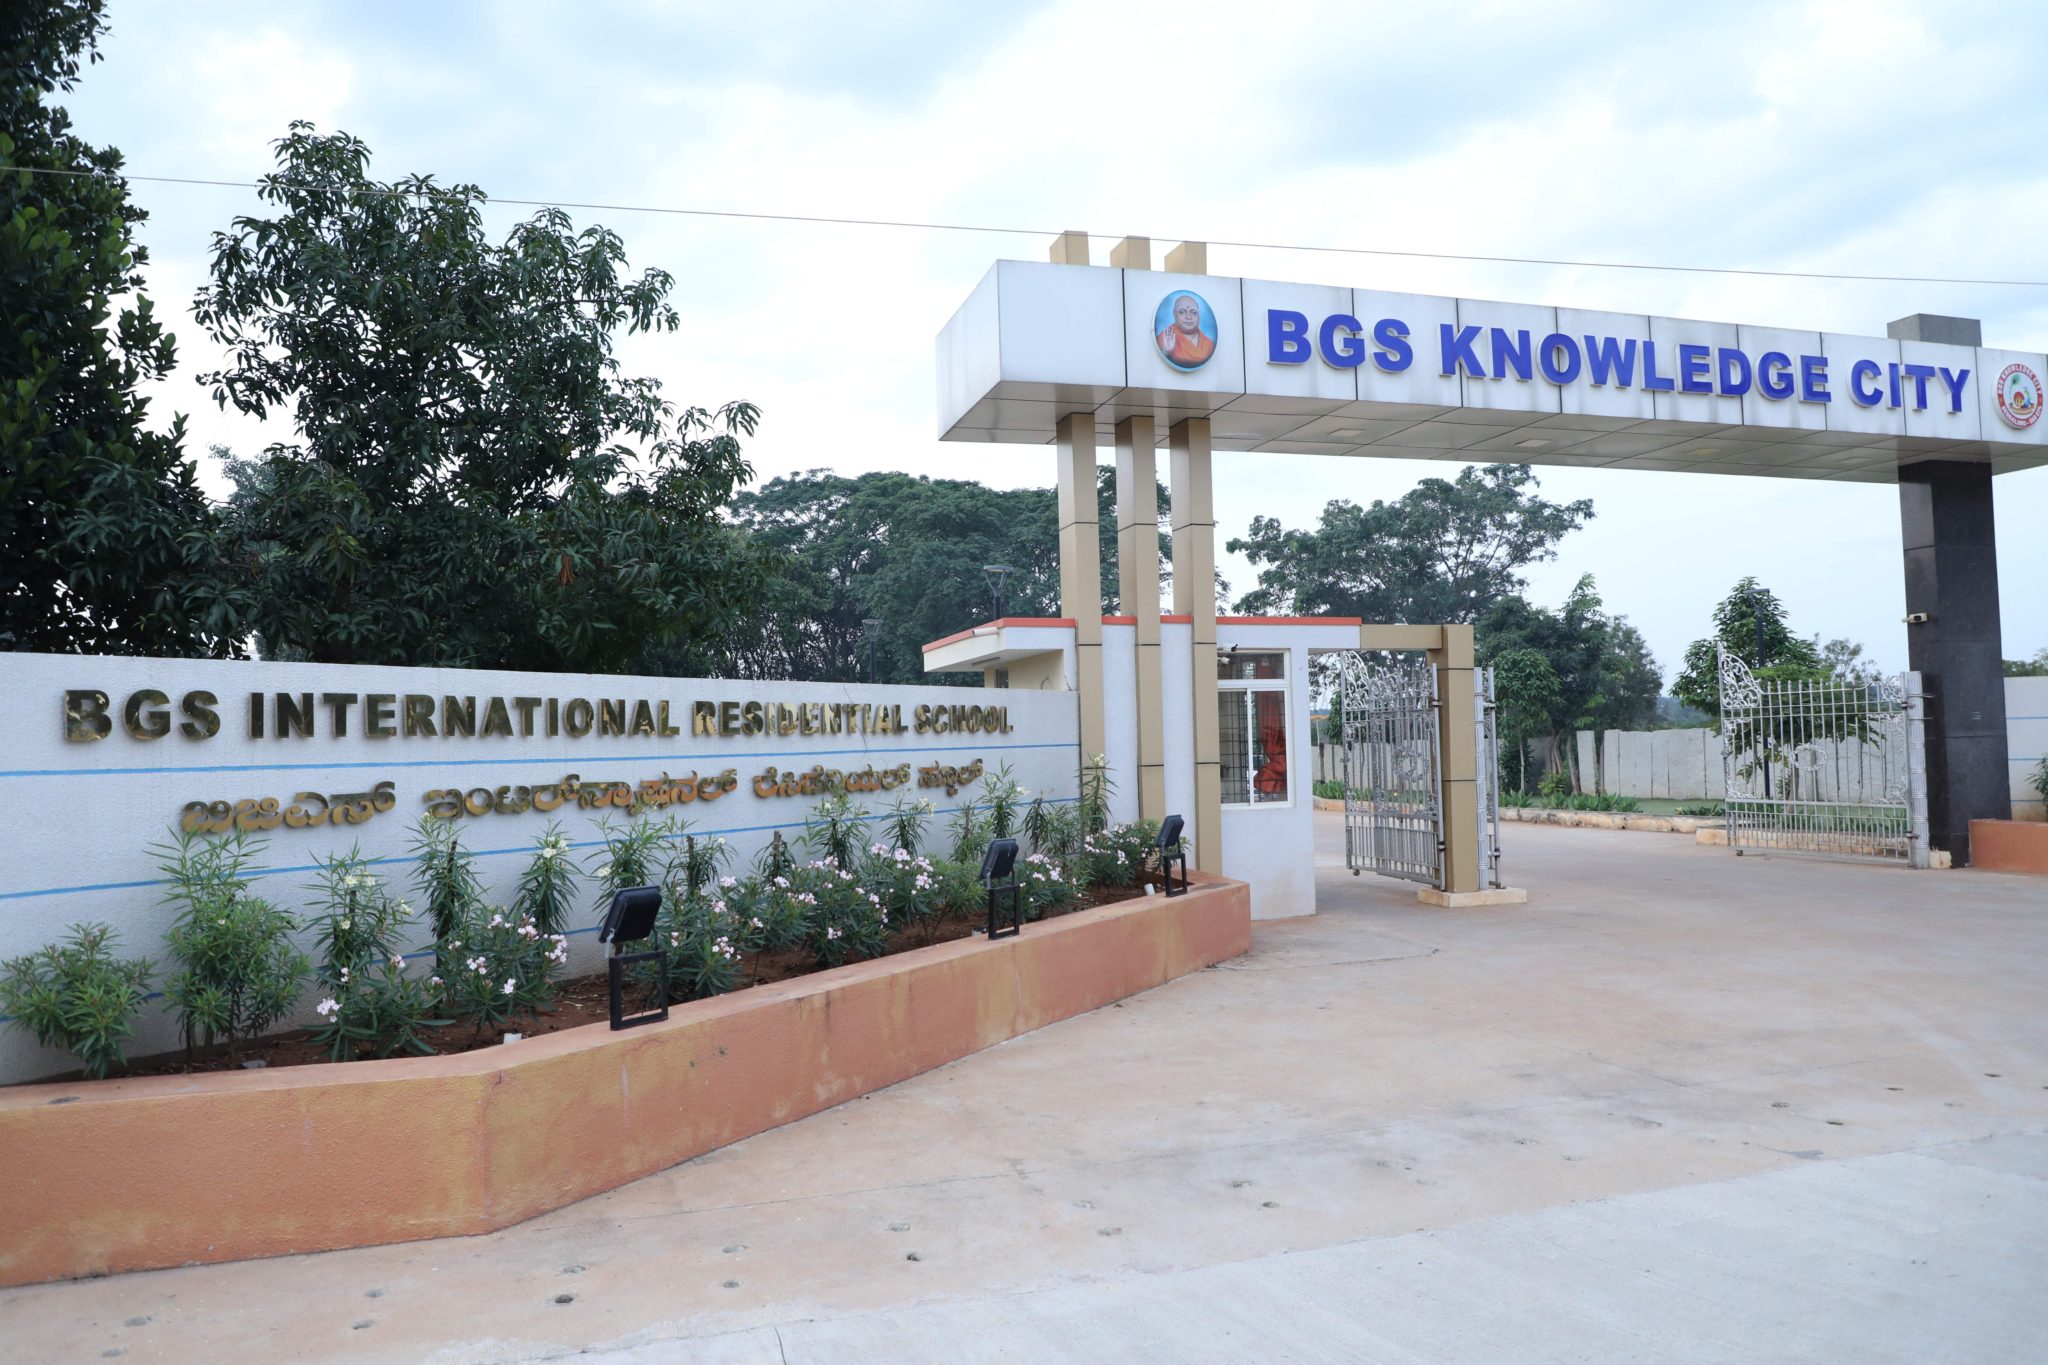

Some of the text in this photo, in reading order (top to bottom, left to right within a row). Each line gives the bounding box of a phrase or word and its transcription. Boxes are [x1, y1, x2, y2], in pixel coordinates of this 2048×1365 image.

[1267, 309, 1971, 414] BGS KNOWLEDGE CITY
[63, 688, 1014, 744] BGS INTERNATIONAL RESIDENTIAL SCHOOL
[182, 780, 396, 834] ಬಿಜಿಎಸ್
